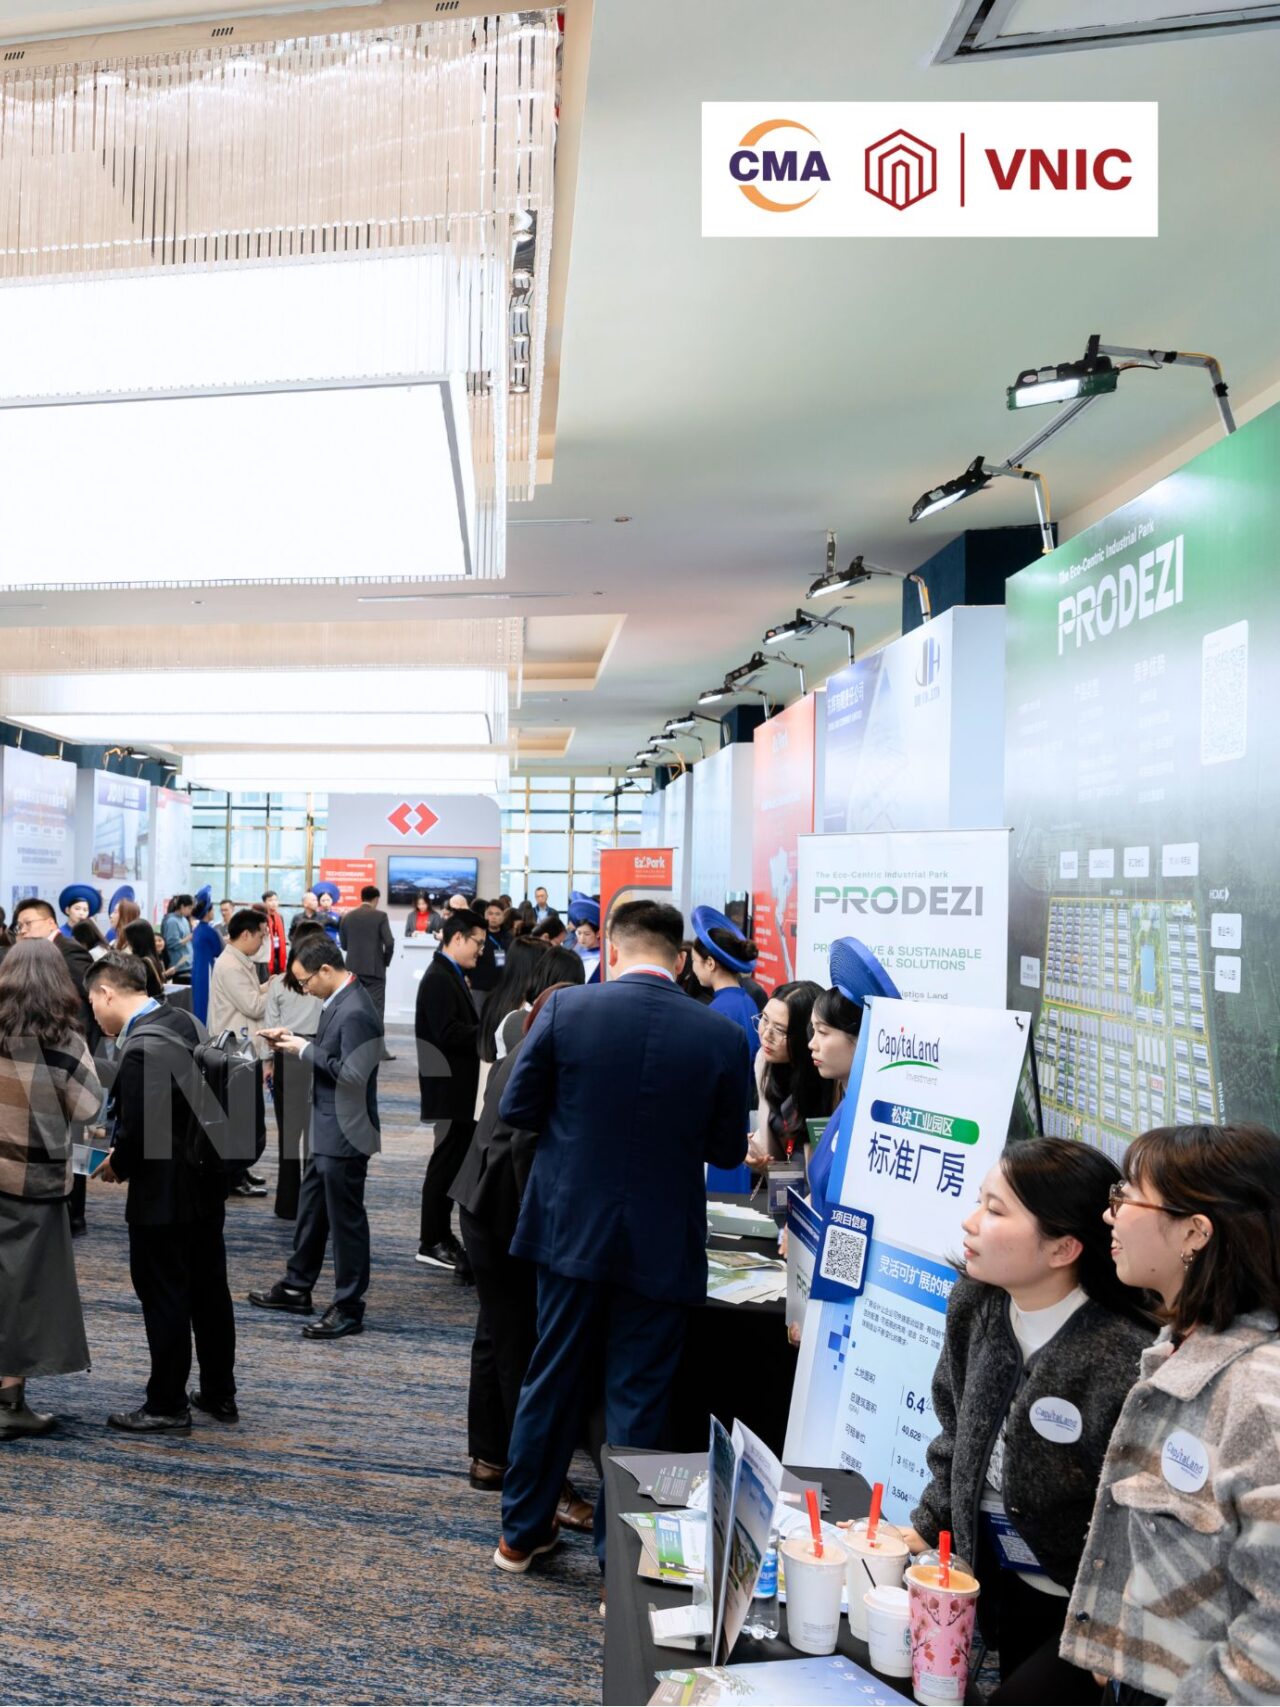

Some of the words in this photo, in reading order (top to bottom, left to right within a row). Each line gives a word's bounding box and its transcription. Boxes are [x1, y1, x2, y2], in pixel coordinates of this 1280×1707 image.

[1070, 548, 1105, 579] Eco-Centric
[1105, 528, 1137, 558] Industrial
[1138, 519, 1155, 539] Park
[1058, 534, 1184, 655] PRODEZI
[816, 871, 830, 879] The
[832, 871, 883, 879] Eco-Centric
[884, 871, 926, 879] Industrial
[929, 870, 949, 879] Park
[814, 886, 984, 916] PRODEZI
[887, 946, 895, 956] &
[898, 946, 982, 960] SUSTAINABLE
[895, 958, 966, 971] SOLUTIONS
[902, 990, 924, 999] istics
[926, 990, 949, 1000] Land
[877, 1027, 941, 1063] CapitaLand
[868, 1131, 966, 1198] 标准厂房
[831, 1209, 868, 1232] 项目信息
[906, 1391, 925, 1415] 6.4
[1034, 1405, 1079, 1429] CapitaLand
[1166, 1441, 1204, 1475] CapitaLand
